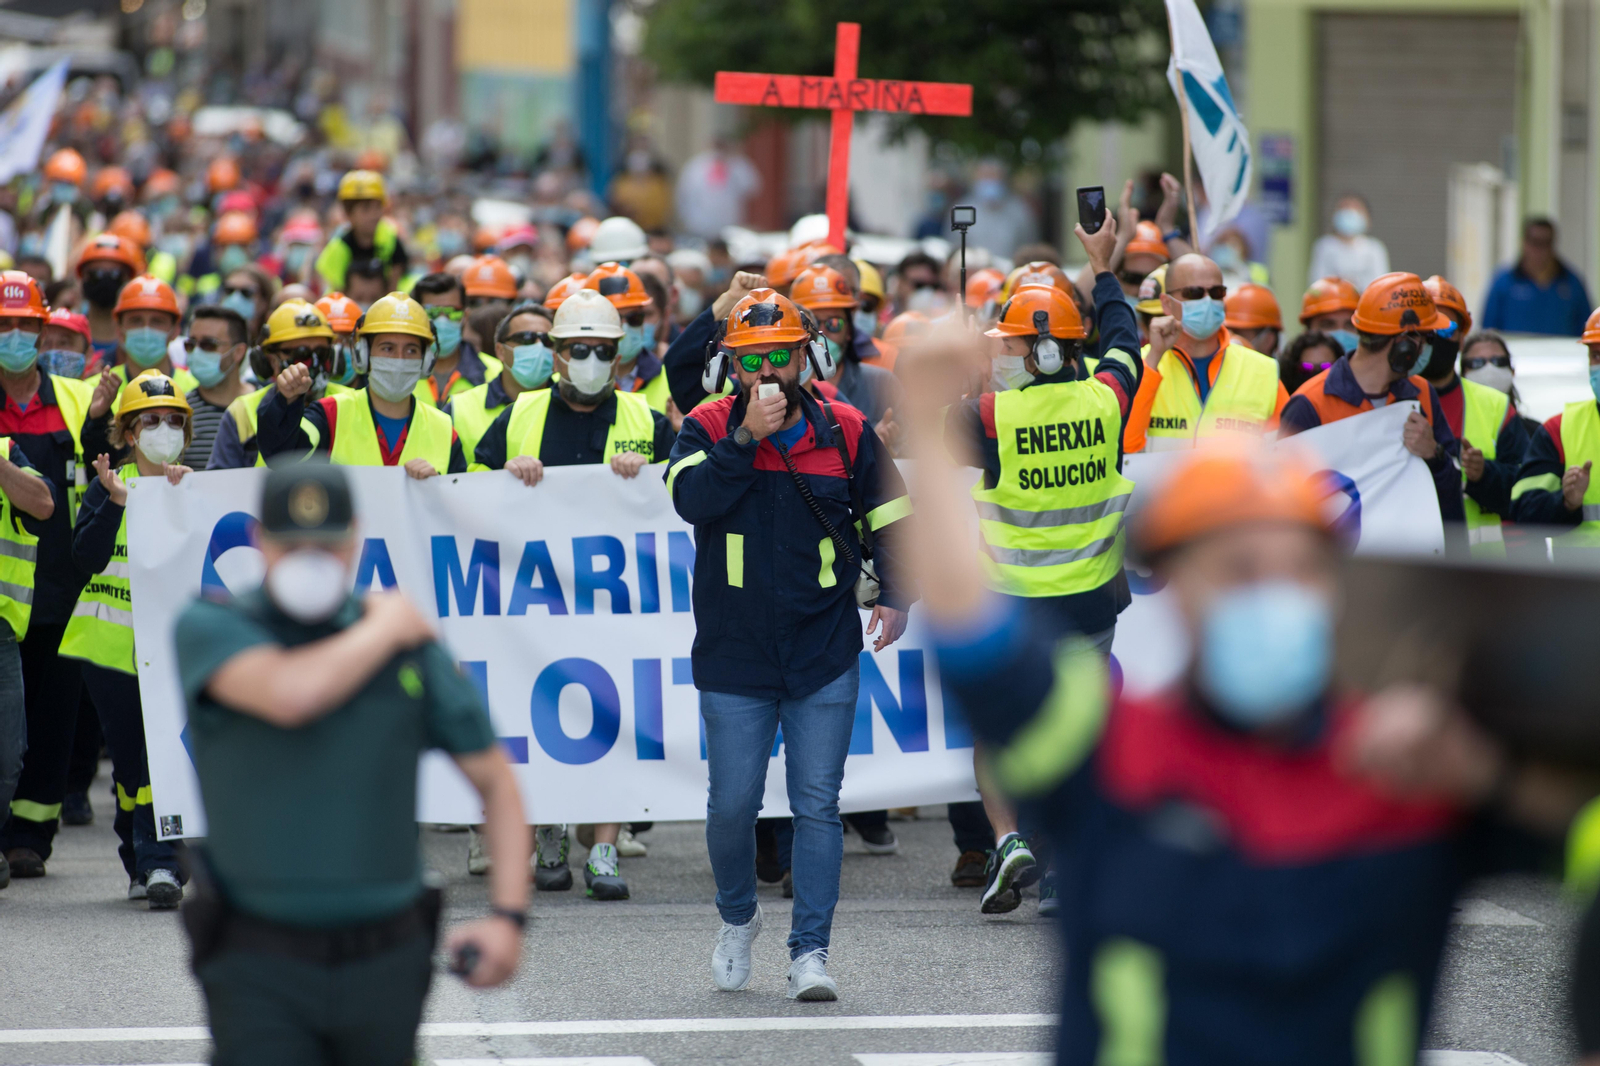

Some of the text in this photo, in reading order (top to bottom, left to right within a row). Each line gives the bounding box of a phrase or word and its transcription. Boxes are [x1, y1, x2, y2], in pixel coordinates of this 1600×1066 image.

[760, 78, 785, 107] A
[1015, 417, 1106, 455] ENERXIA
[1018, 454, 1107, 490] SOLUCIÓN
